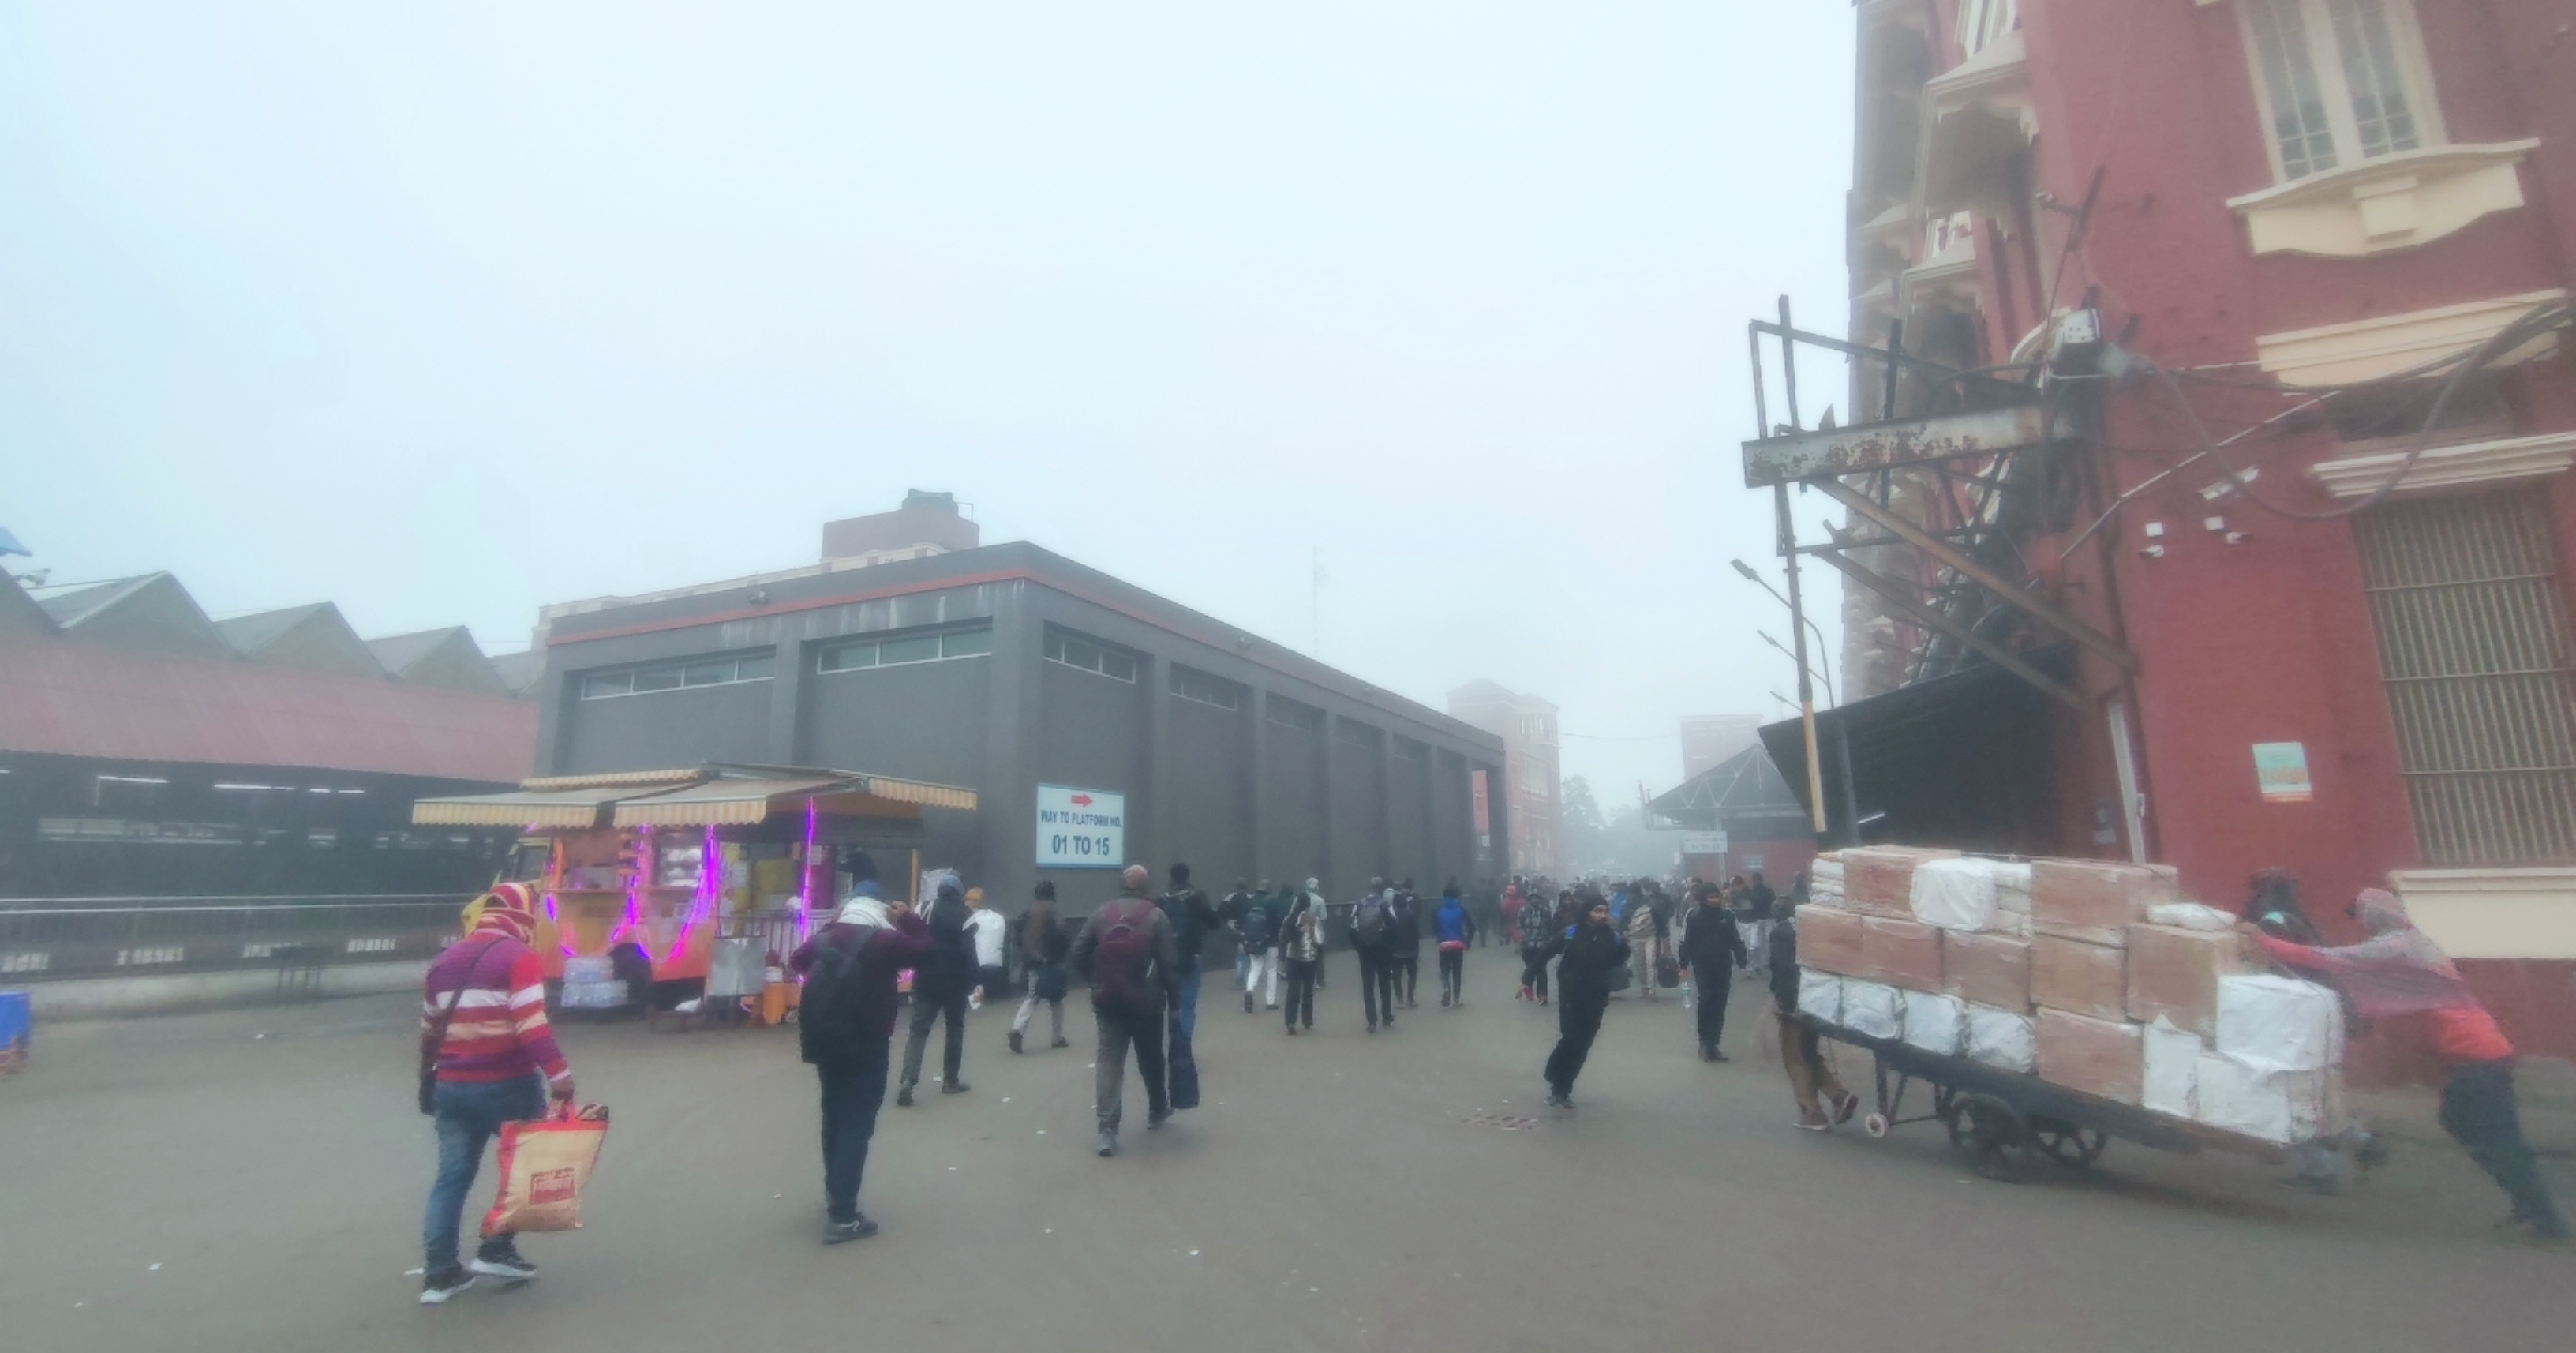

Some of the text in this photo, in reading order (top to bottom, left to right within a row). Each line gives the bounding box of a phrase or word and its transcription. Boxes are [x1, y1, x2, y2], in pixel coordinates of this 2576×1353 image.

[1041, 810, 1122, 827] WAY TO PLATFORM NO.
[1052, 834, 1110, 856] 01 TO 15
